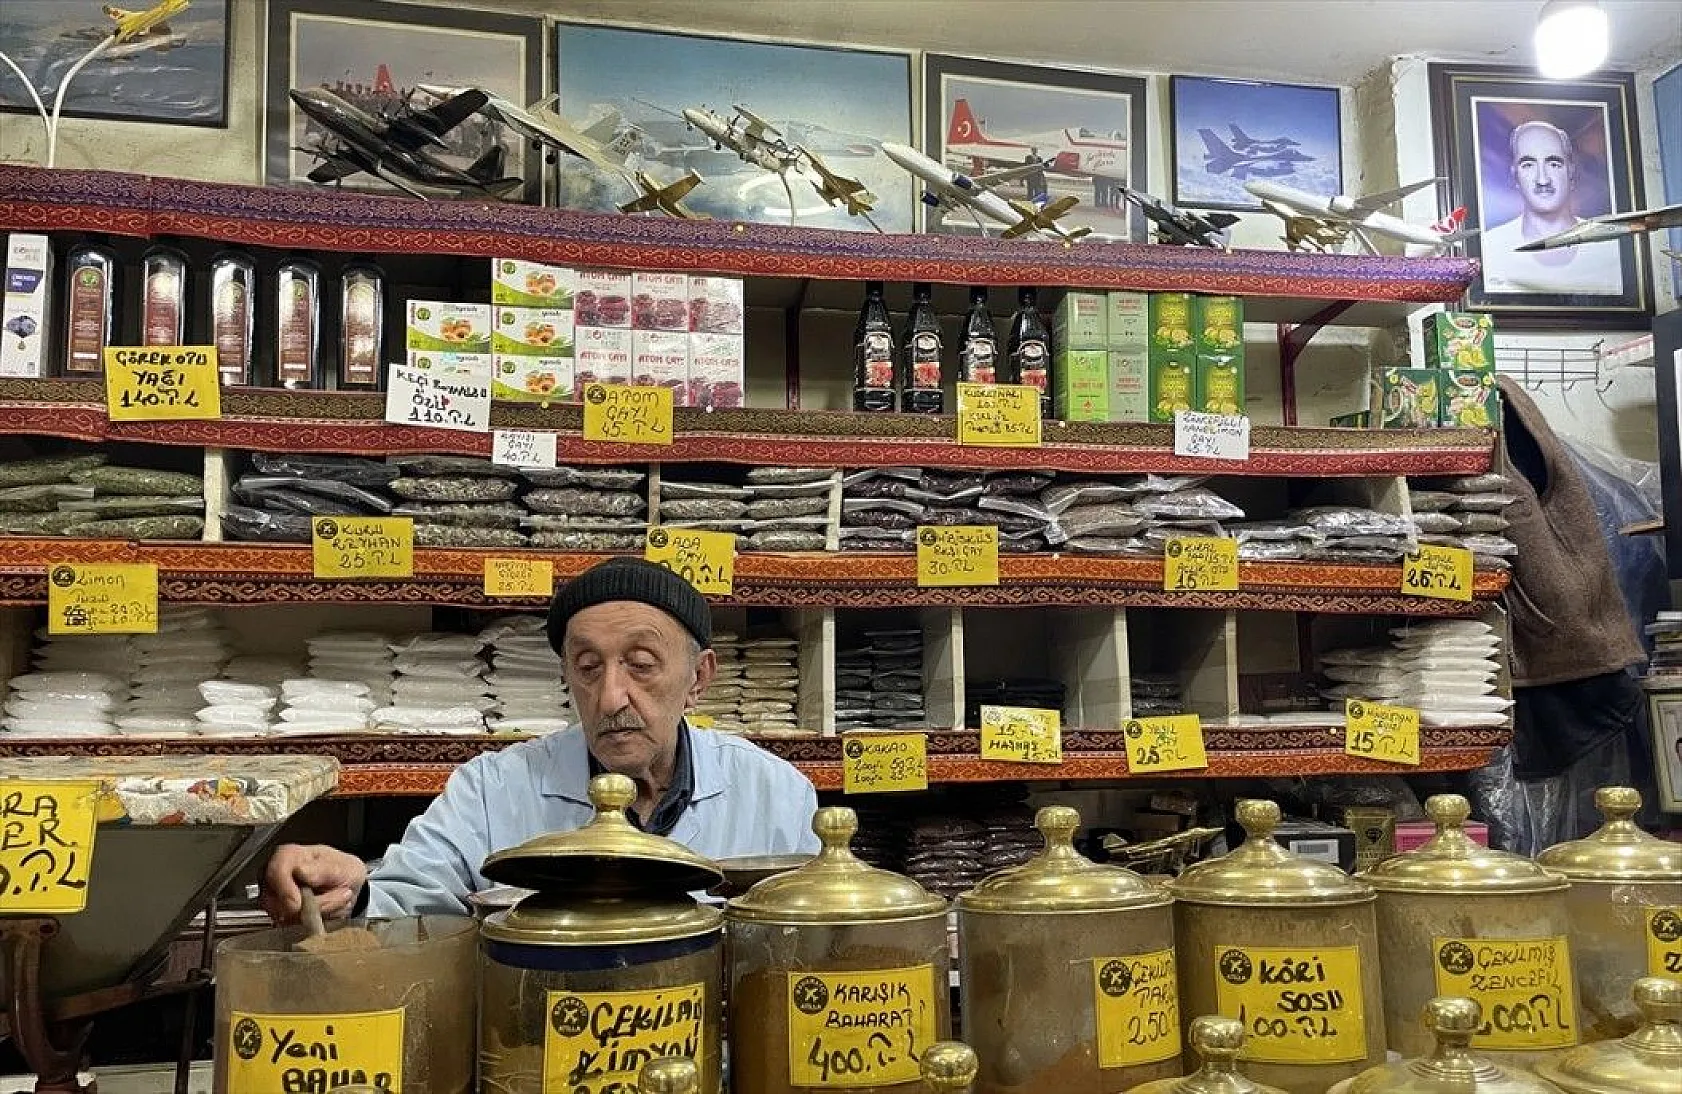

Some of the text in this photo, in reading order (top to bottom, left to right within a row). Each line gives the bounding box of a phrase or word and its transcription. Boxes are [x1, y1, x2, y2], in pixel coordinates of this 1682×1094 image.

[175, 351, 208, 366] OTU
[132, 369, 185, 387] YAĞI
[607, 389, 659, 408] ATOM
[0, 791, 58, 819] RA
[2, 820, 78, 851] ER
[834, 982, 911, 1006] KARIŞIK
